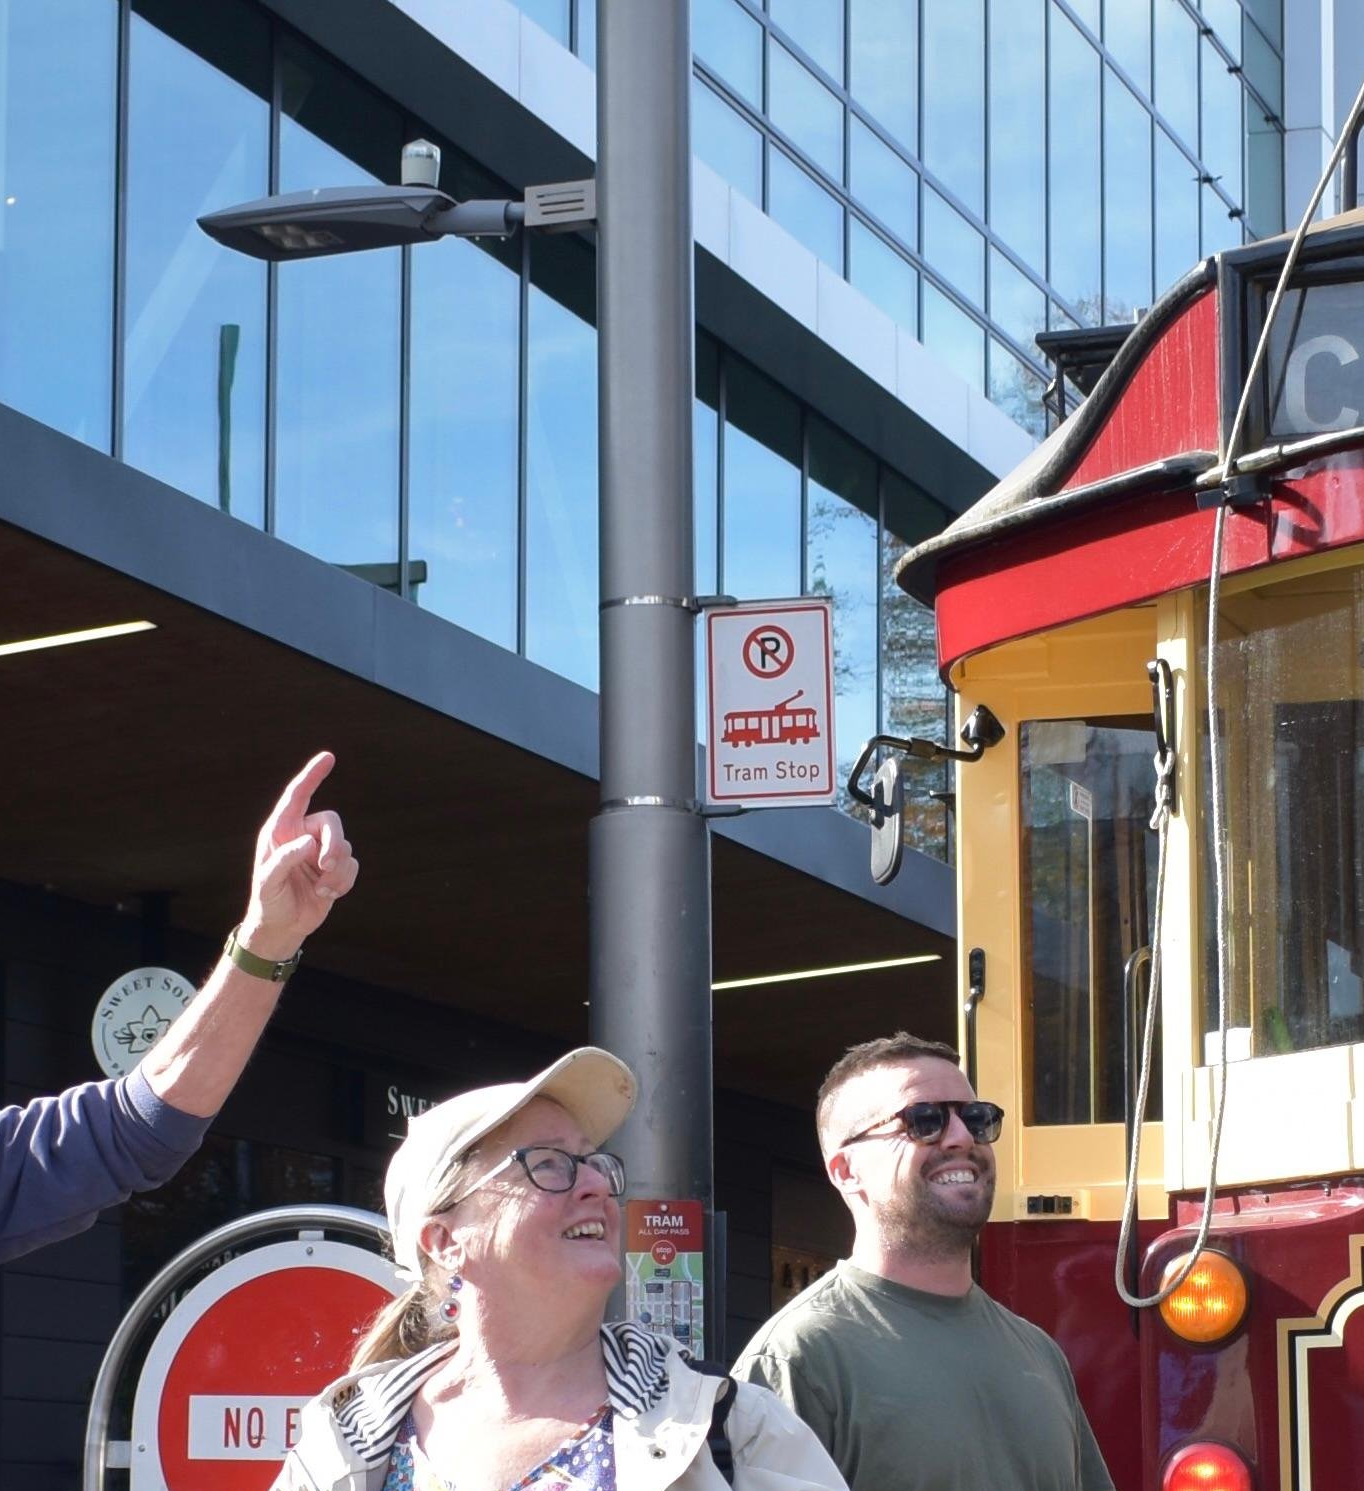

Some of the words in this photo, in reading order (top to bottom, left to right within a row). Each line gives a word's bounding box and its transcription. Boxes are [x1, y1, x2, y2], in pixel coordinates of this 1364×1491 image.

[723, 763, 768, 782] Tram
[775, 760, 820, 783] Stop
[101, 976, 152, 1020] SWEET
[644, 1215, 684, 1227] TRAM
[224, 1407, 264, 1449] NO
